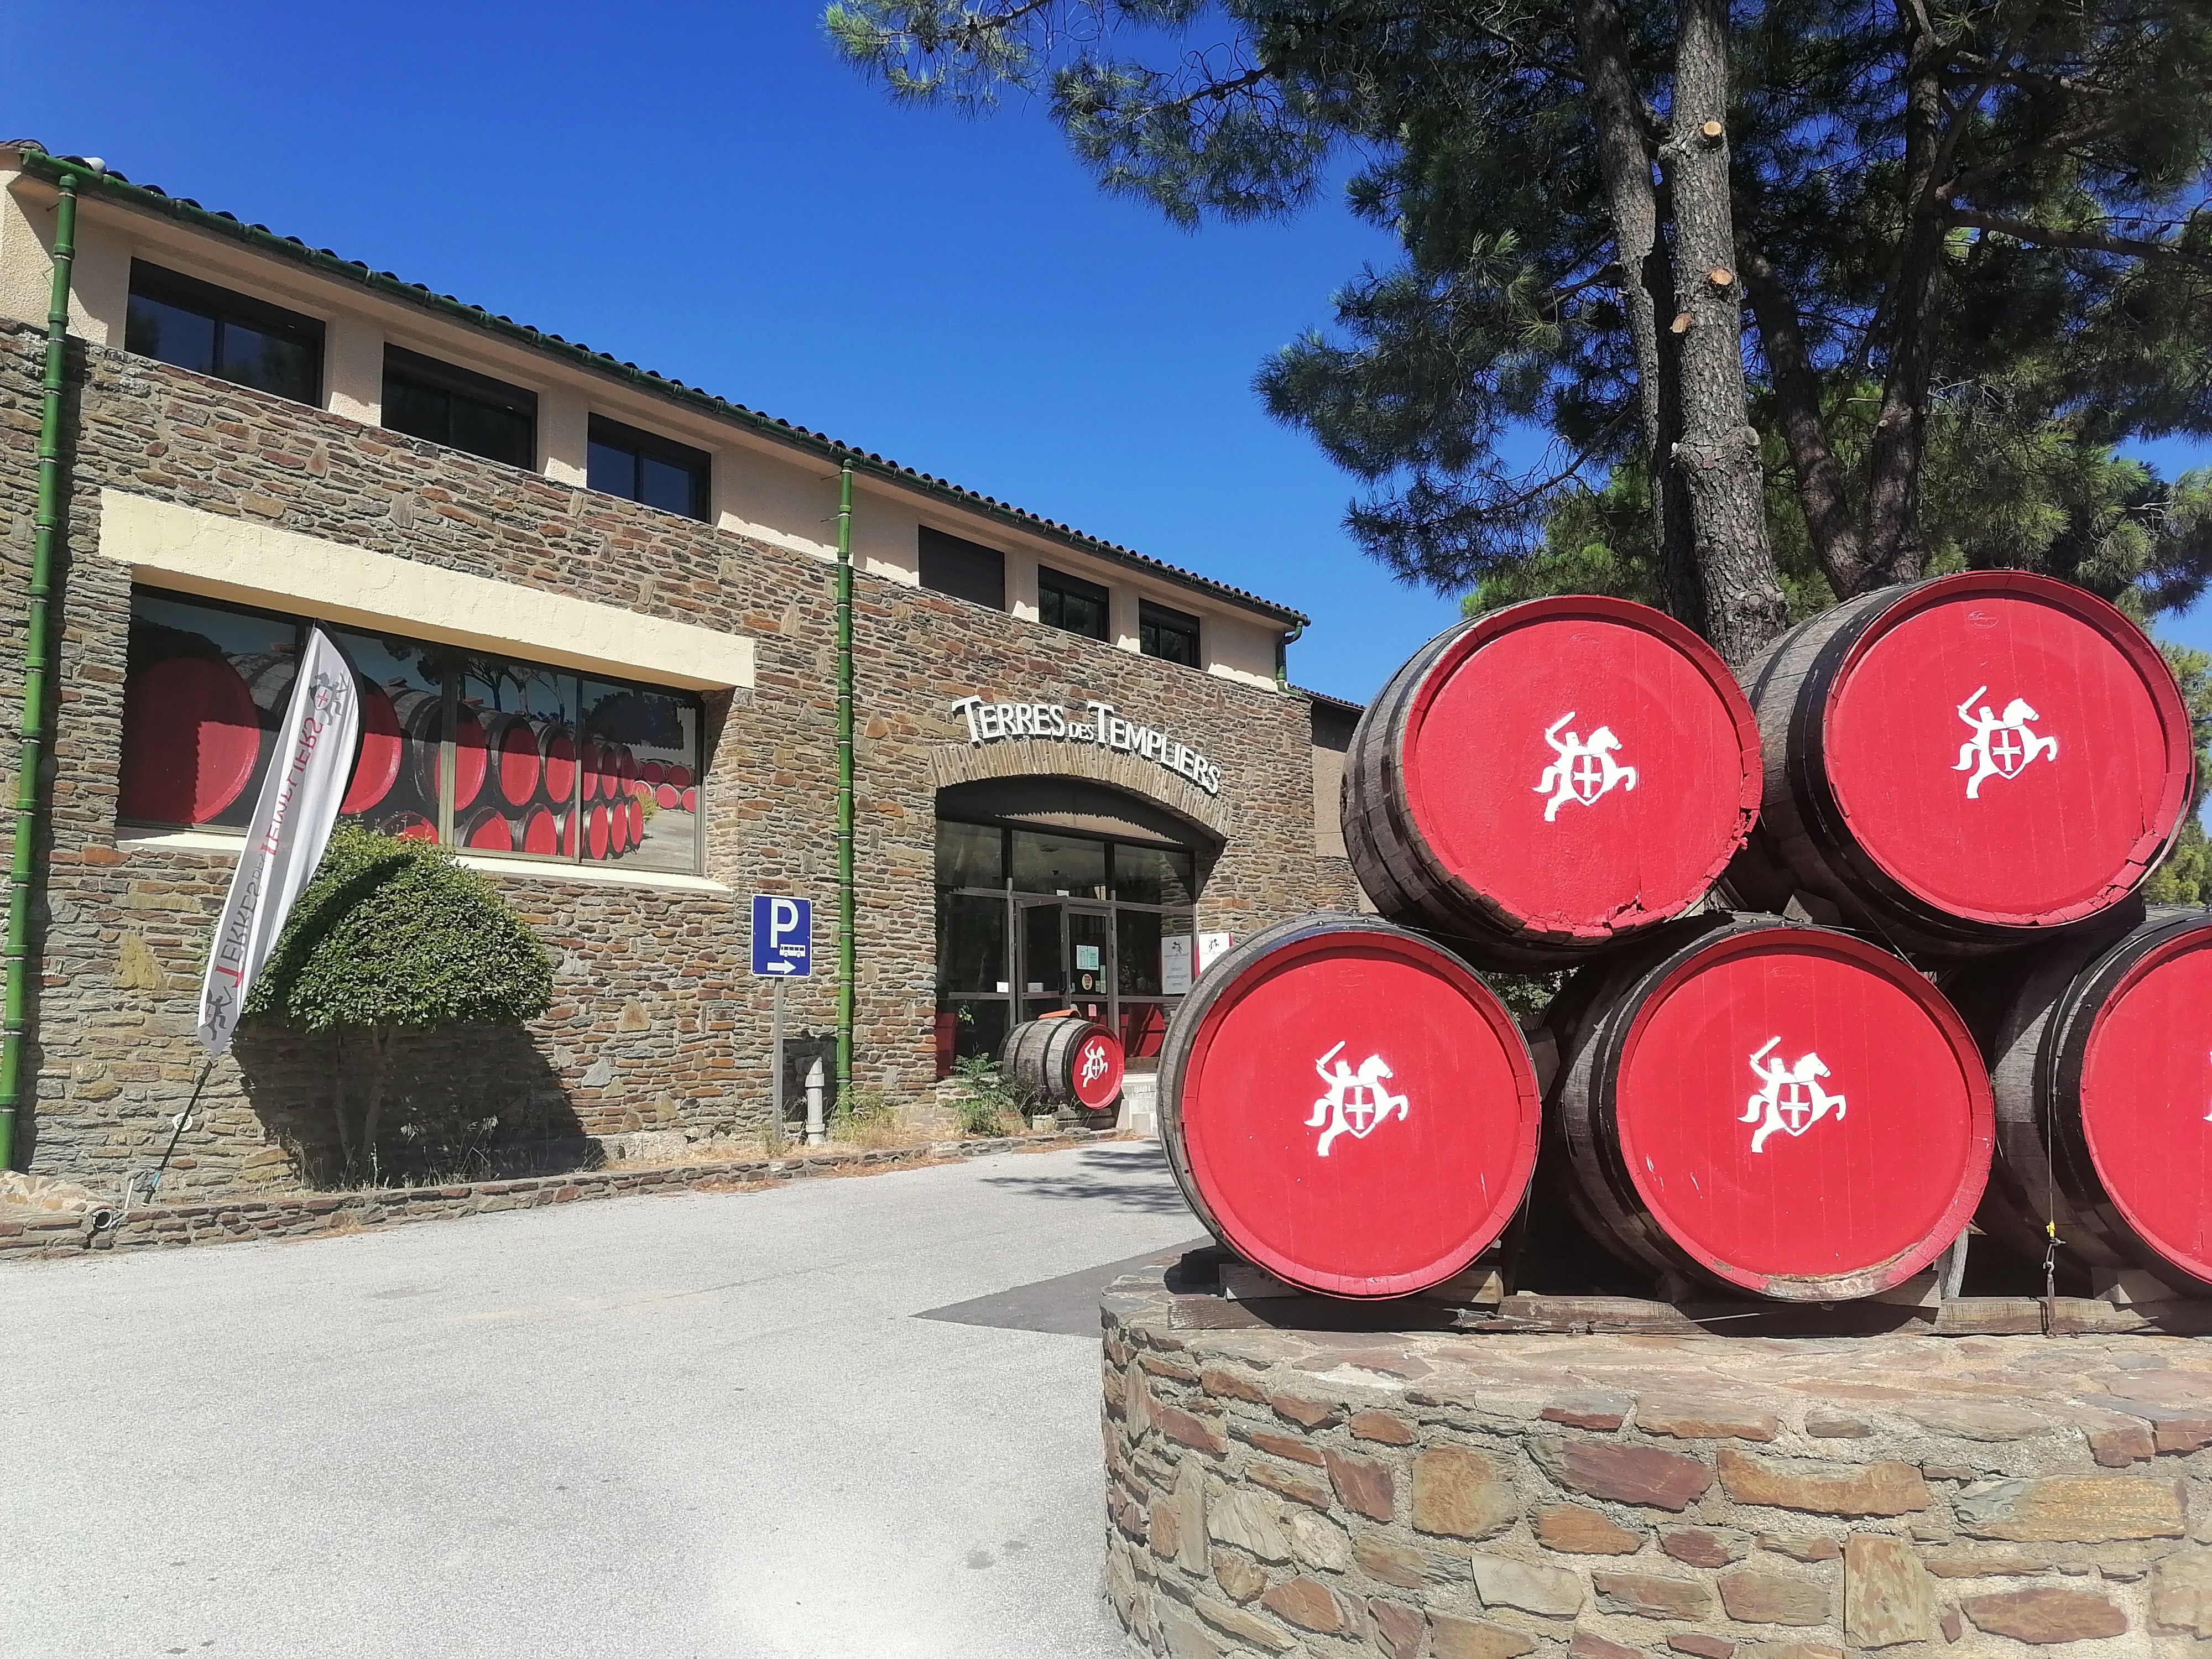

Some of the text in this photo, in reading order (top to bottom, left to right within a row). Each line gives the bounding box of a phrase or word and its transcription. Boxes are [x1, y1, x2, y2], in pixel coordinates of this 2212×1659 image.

[951, 695, 1222, 794] TERRES DES TEMPLIERS
[770, 898, 799, 948] P
